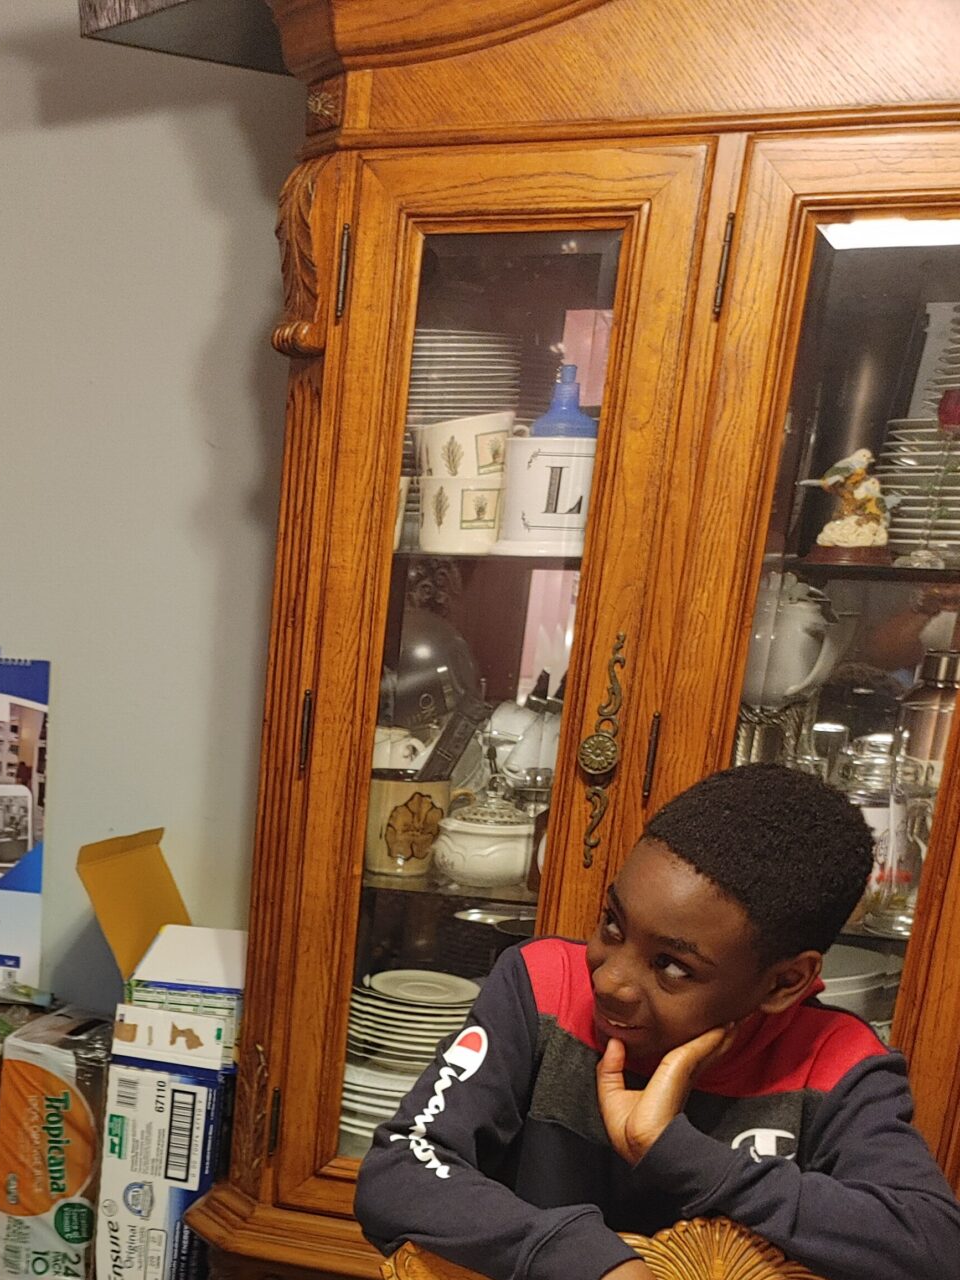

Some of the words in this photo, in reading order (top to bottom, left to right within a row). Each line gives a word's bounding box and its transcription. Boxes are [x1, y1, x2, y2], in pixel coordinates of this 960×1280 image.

[541, 466, 583, 514] L
[155, 1080, 166, 1113] 67110
[42, 1091, 71, 1193] Tropicana
[123, 1225, 140, 1270] Original
[181, 1224, 190, 1254] ENERGY
[32, 1251, 49, 1275] 10
[63, 1253, 81, 1277] 24
